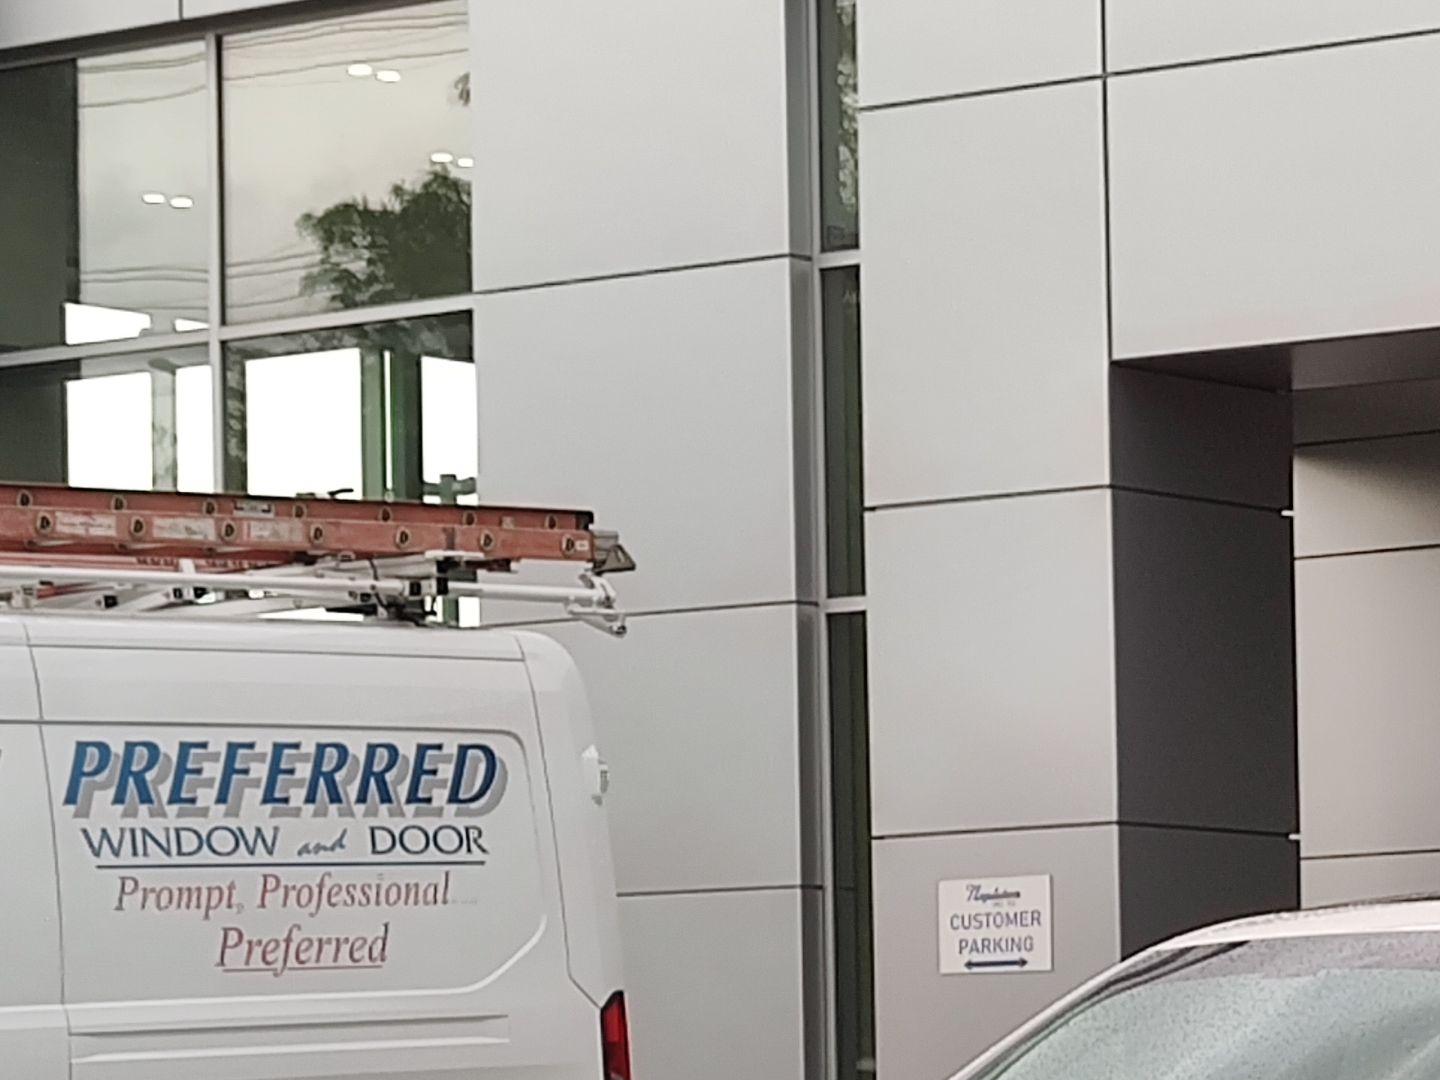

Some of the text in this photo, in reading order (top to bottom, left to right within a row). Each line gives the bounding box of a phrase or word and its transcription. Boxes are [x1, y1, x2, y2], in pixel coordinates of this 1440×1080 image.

[62, 740, 508, 819] PREFERRED
[80, 824, 489, 858] WINDOW and DOOR
[114, 875, 245, 920] Prompt,
[949, 909, 1042, 931] CUSTOMER
[214, 922, 390, 977] Preferred
[958, 935, 1034, 955] PARKING
